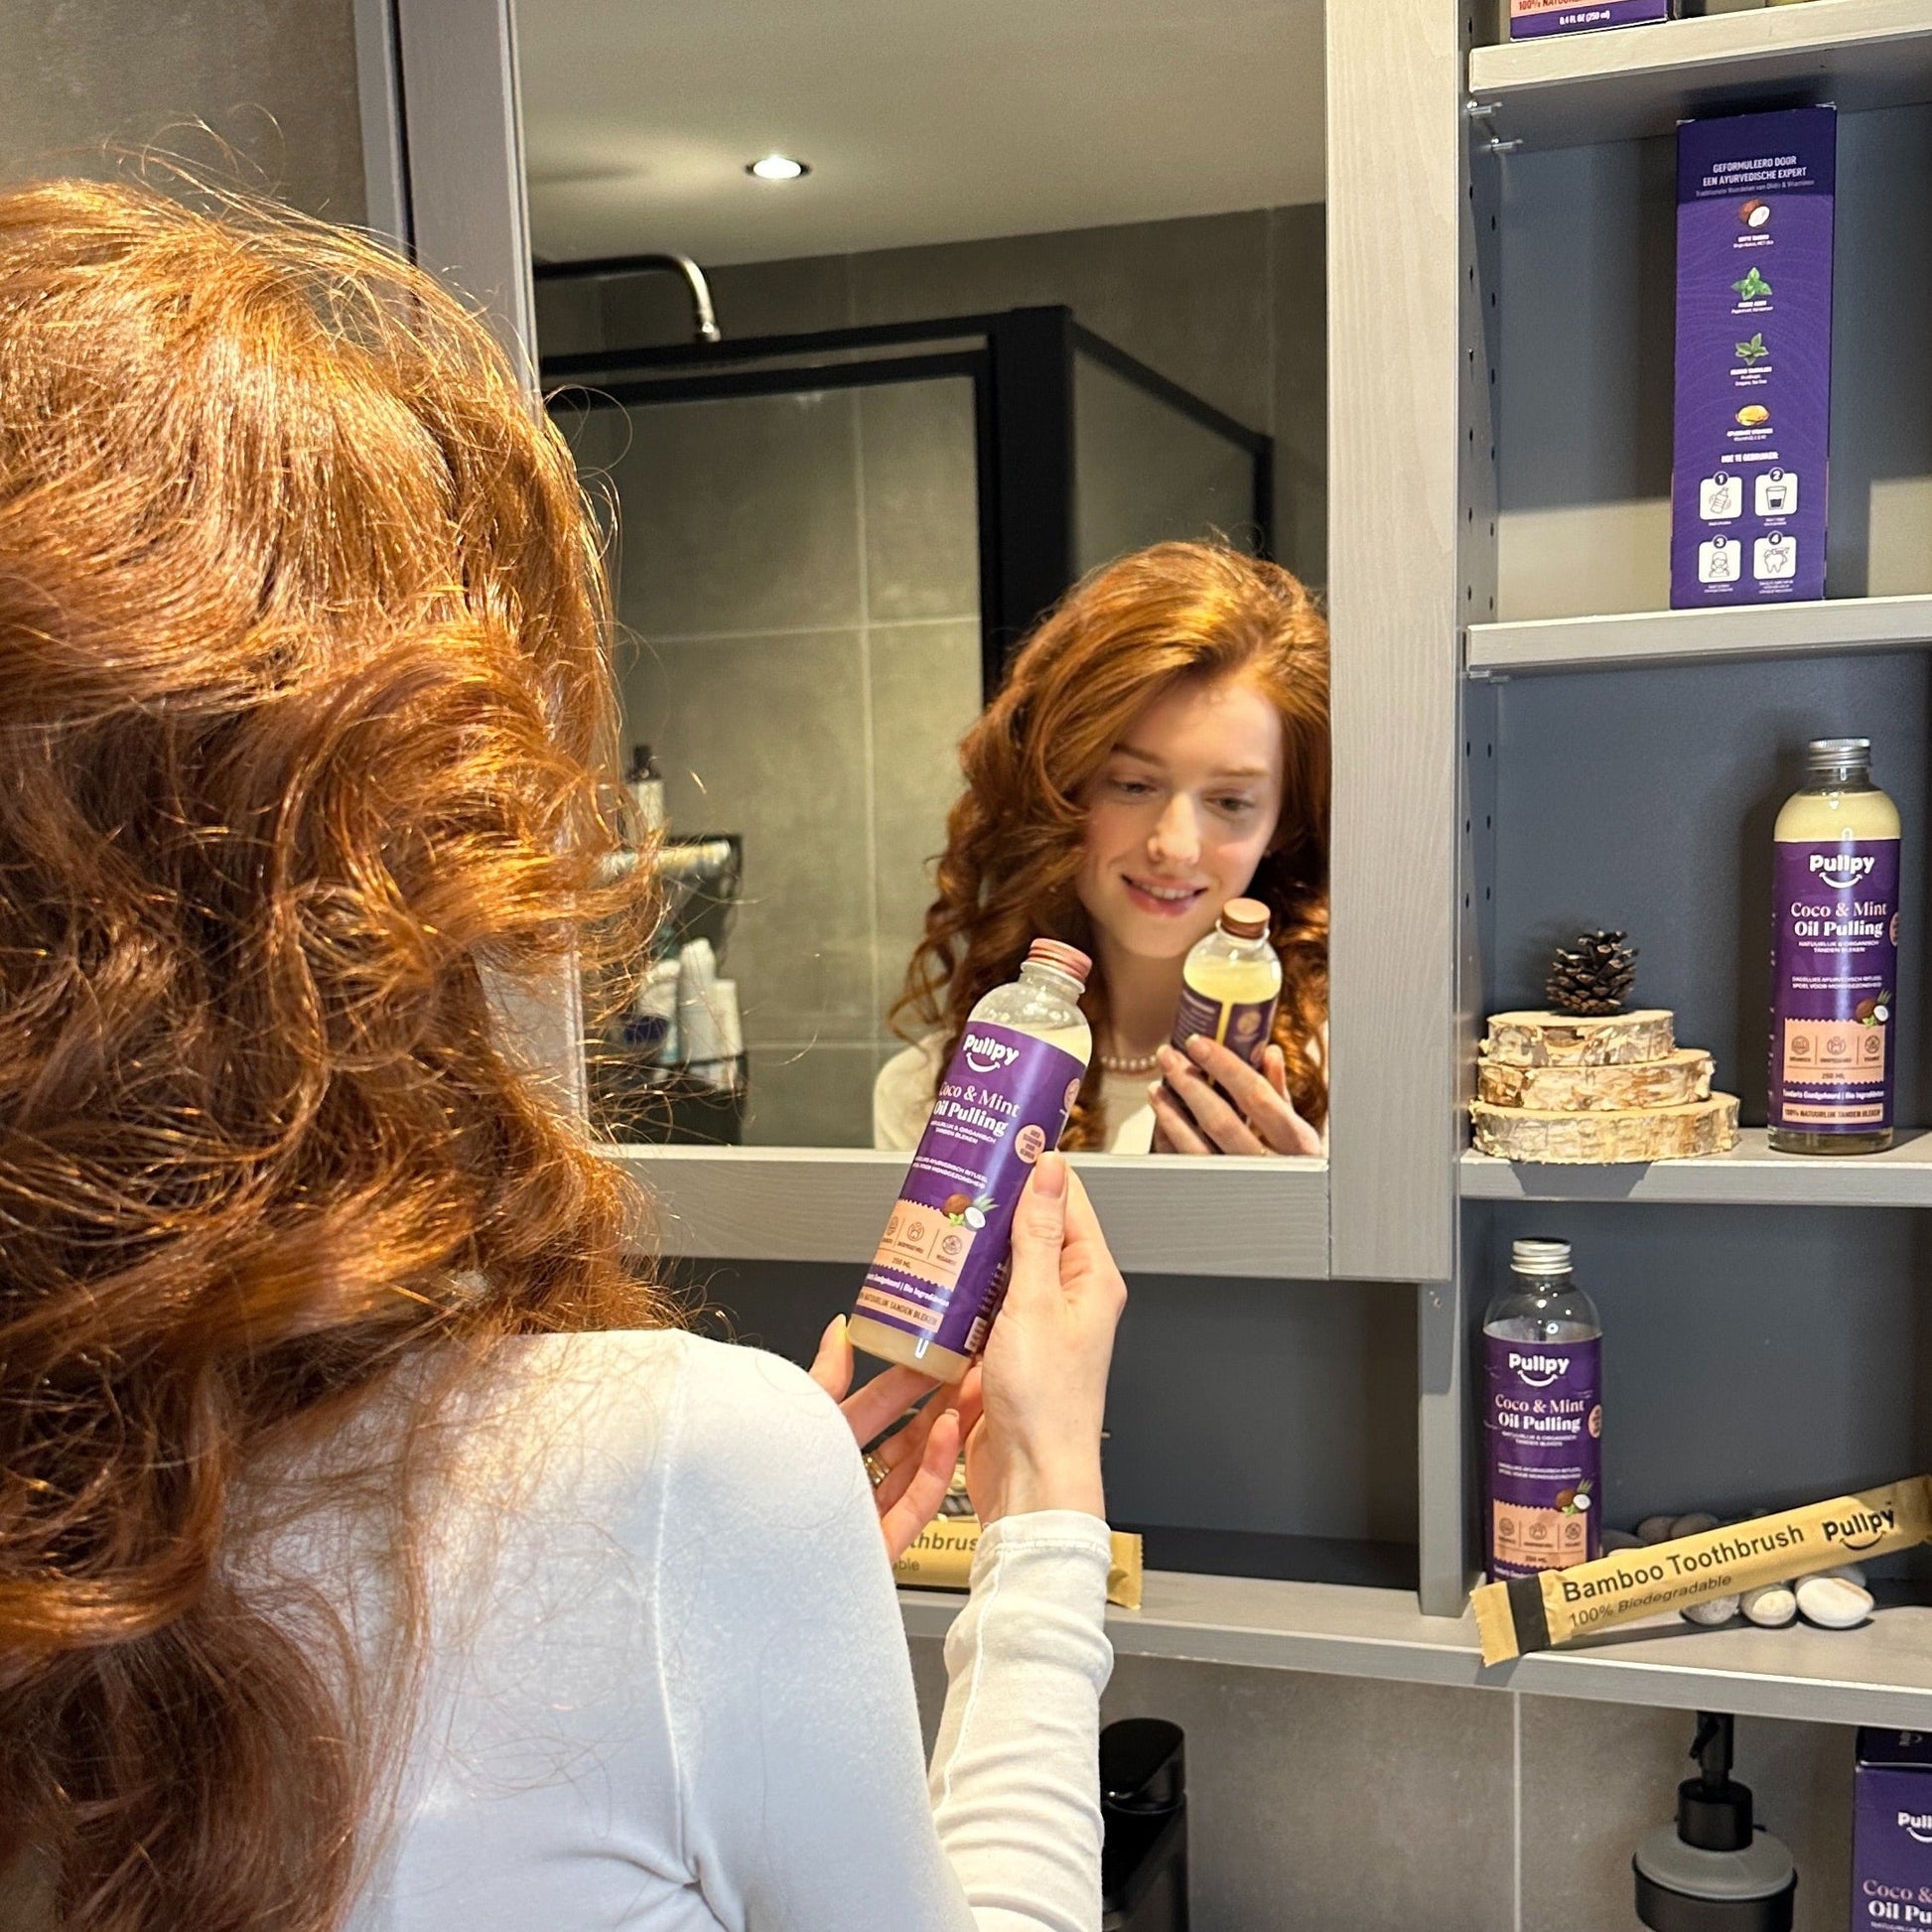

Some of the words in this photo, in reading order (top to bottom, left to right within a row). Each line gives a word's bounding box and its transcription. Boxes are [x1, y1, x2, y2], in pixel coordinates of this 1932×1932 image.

[1713, 158, 1773, 173] GEFORMULEERD
[1774, 155, 1797, 167] DOOR
[1703, 177, 1718, 187] EEN
[1719, 170, 1777, 185] AYURVEDISCHE
[1778, 167, 1807, 179] EXPERT
[1719, 475, 1724, 483] 1
[1773, 471, 1780, 480] 2
[1770, 534, 1779, 543] 4
[1810, 855, 1874, 874] Pullpy
[1791, 902, 1831, 917] Coco
[1835, 902, 1849, 917] &
[1854, 901, 1886, 916] Mint
[1794, 921, 1819, 936] Oil
[1824, 920, 1883, 937] Pulling
[963, 1035, 1020, 1066] Pullpy
[963, 1085, 977, 1103] &
[978, 1090, 1021, 1118] Mint
[933, 1100, 947, 1116] Oil
[948, 1102, 1010, 1138] Pulling
[1509, 1353, 1570, 1374] Pullpy
[1495, 1394, 1529, 1412] Coco
[1533, 1399, 1547, 1414] &
[1550, 1399, 1584, 1413] Mint
[1498, 1412, 1519, 1429] Oil
[1523, 1416, 1582, 1433] Pulling
[1822, 1508, 1895, 1541] Pullpy
[1562, 1565, 1664, 1602] Bamboo
[1666, 1525, 1805, 1576] Toothbrush
[1569, 1604, 1613, 1627] 100%
[1617, 1575, 1731, 1613] Biodegradable
[1863, 1879, 1912, 1900] Coco
[1918, 1886, 1932, 1903] &
[1868, 1899, 1899, 1920] Oil
[1905, 1904, 1932, 1924] Pu
